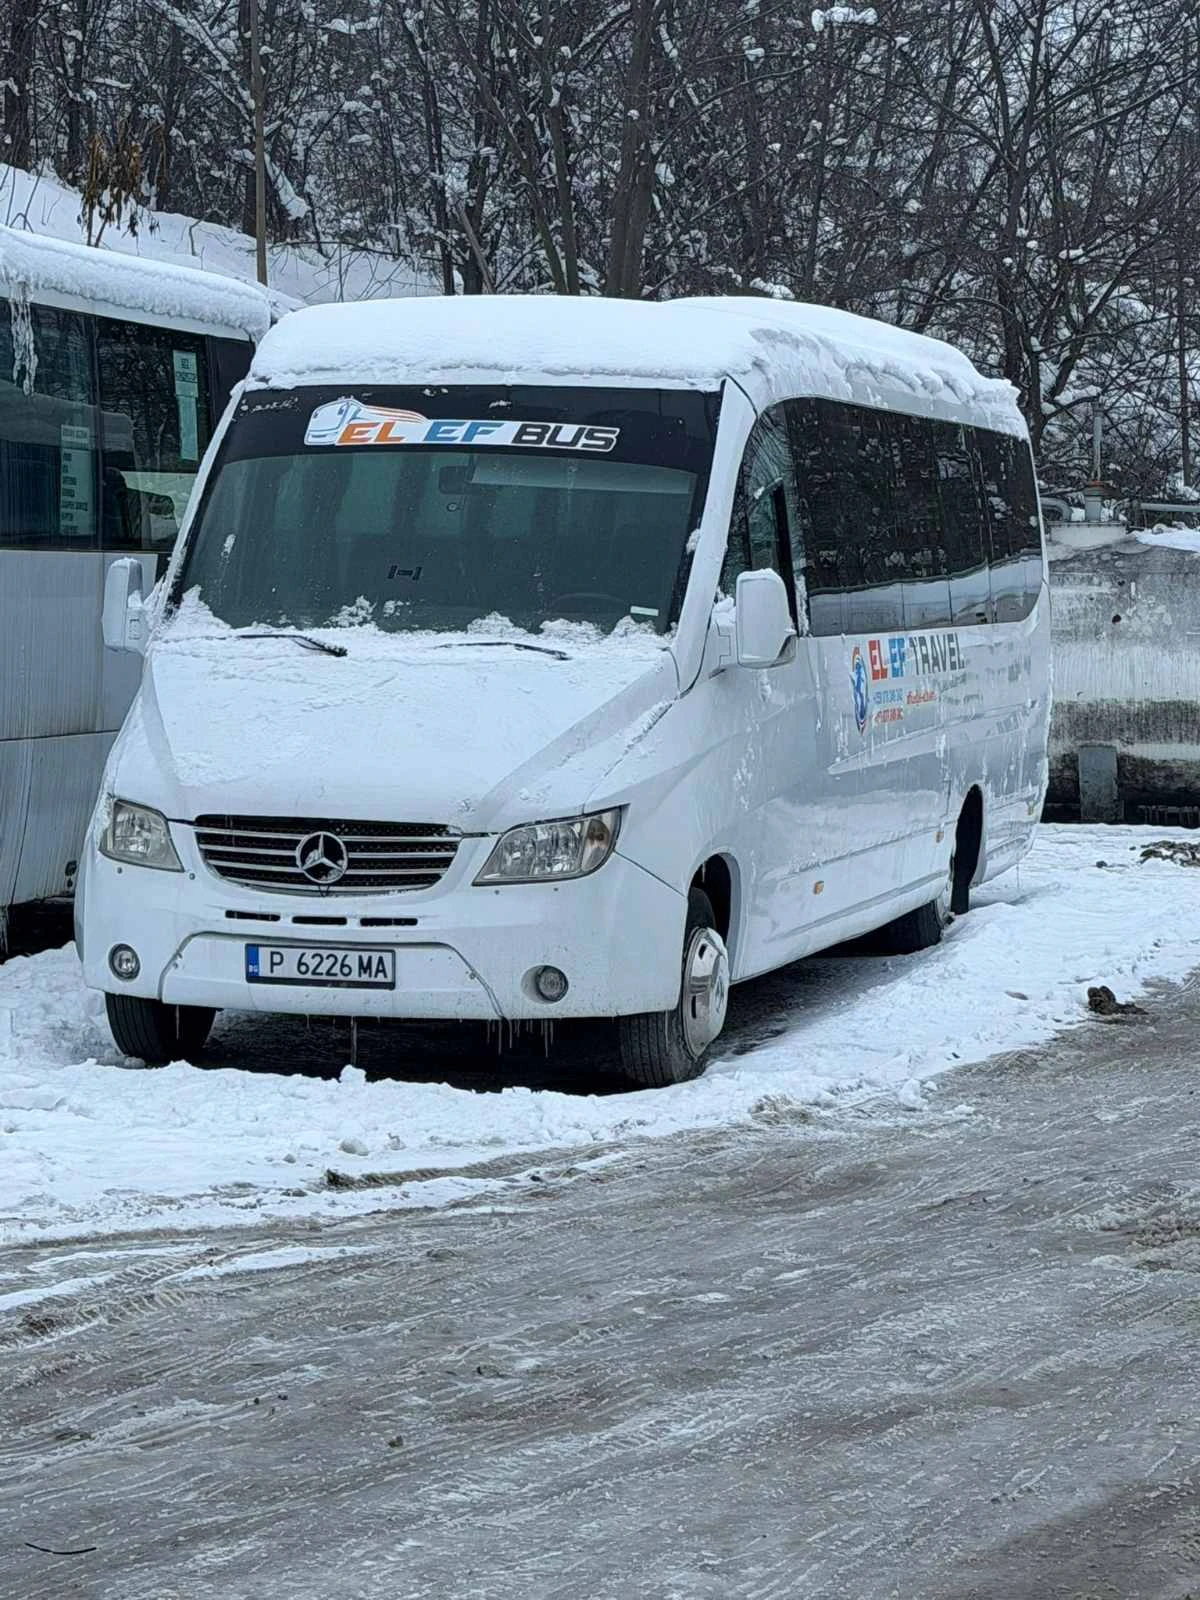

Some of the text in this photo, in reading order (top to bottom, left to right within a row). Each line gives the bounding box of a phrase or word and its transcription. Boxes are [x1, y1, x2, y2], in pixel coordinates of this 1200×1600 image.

[338, 421, 618, 450] EL EF BUS
[868, 632, 965, 680] EL EF TRAVEL
[269, 951, 388, 979] P 6226 MA
